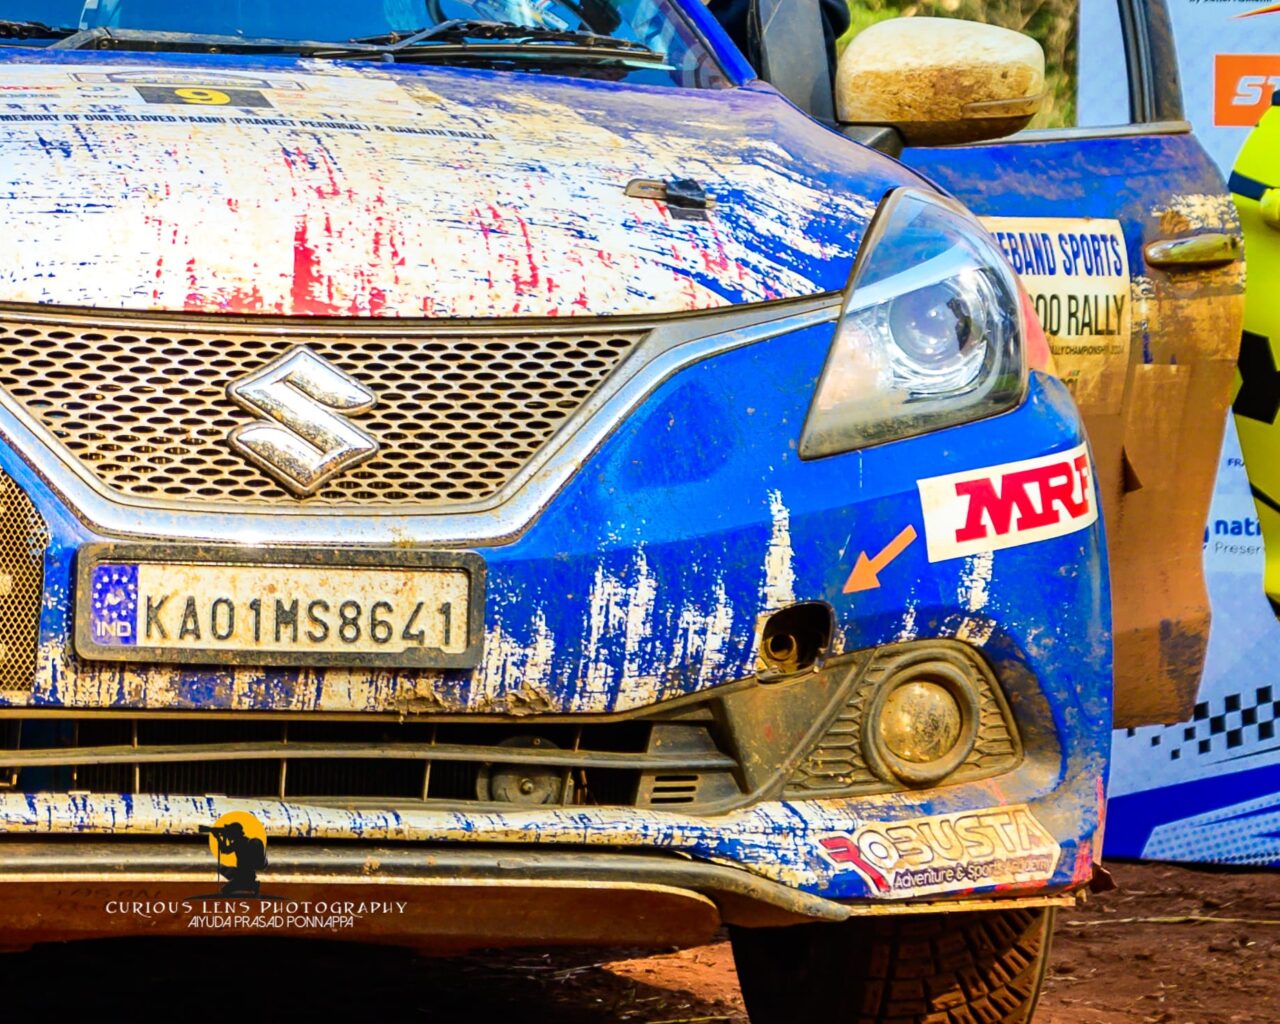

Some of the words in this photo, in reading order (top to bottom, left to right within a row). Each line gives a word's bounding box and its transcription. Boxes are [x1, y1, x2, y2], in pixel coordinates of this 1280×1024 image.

[173, 88, 231, 106] 9
[63, 114, 82, 122] OF
[84, 113, 113, 122] OUR
[117, 114, 177, 123] BELOVED
[1058, 233, 1123, 277] SPORTS
[1067, 294, 1126, 336] RALLY
[96, 619, 131, 638] IND
[144, 593, 453, 645] KA01MS8641
[819, 811, 1043, 892] ROBUSTA
[893, 868, 954, 890] Adventure
